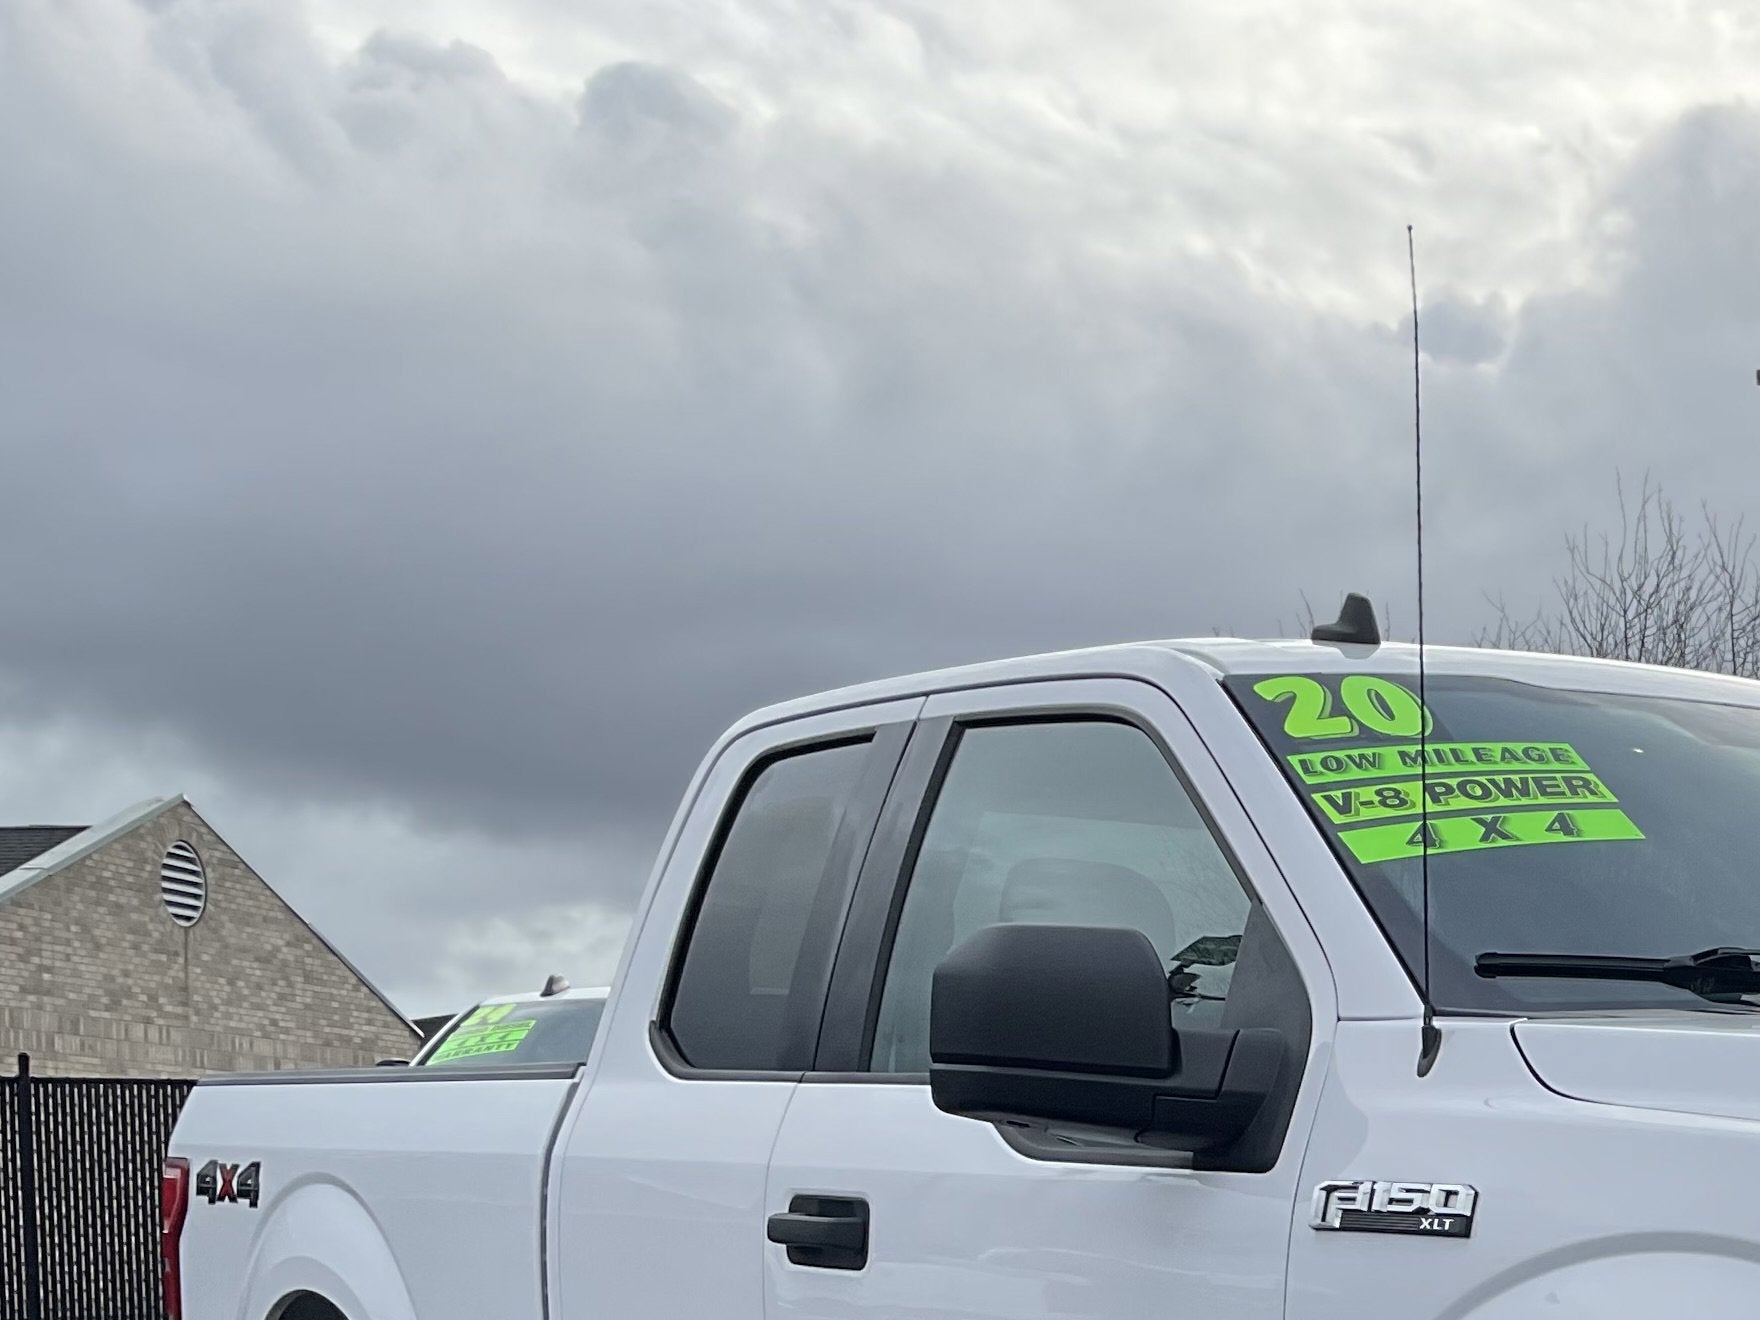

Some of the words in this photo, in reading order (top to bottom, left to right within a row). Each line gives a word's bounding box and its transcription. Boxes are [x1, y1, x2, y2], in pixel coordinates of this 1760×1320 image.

[1252, 675, 1433, 739] 20
[1298, 750, 1381, 777] LOW
[1398, 745, 1577, 769] MILEAGE
[1321, 785, 1417, 818] V-8
[1424, 774, 1602, 806] POWER
[1405, 820, 1439, 850] 4
[1470, 814, 1514, 844] X
[1545, 810, 1579, 838] 4
[1419, 1217, 1455, 1231] XLT
